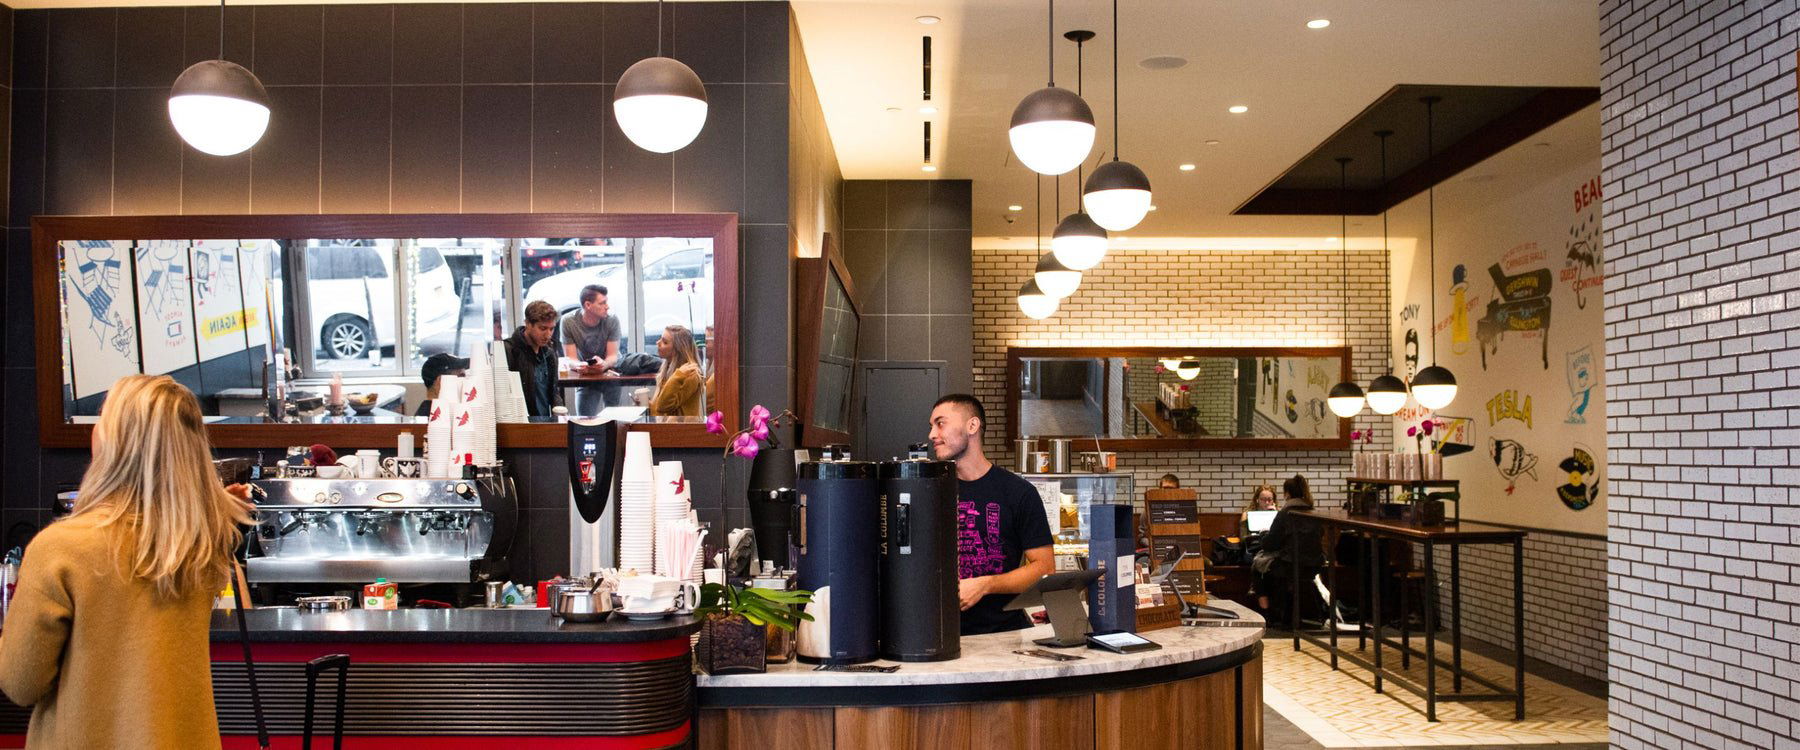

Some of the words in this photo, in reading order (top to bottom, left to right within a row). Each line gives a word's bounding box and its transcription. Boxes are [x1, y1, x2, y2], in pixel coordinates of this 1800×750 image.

[1399, 304, 1421, 327] TONY
[1486, 389, 1533, 430] TESLA
[880, 494, 888, 539] COLOMBE
[880, 543, 888, 555] LA
[1138, 610, 1178, 625] CHOCOLATE
